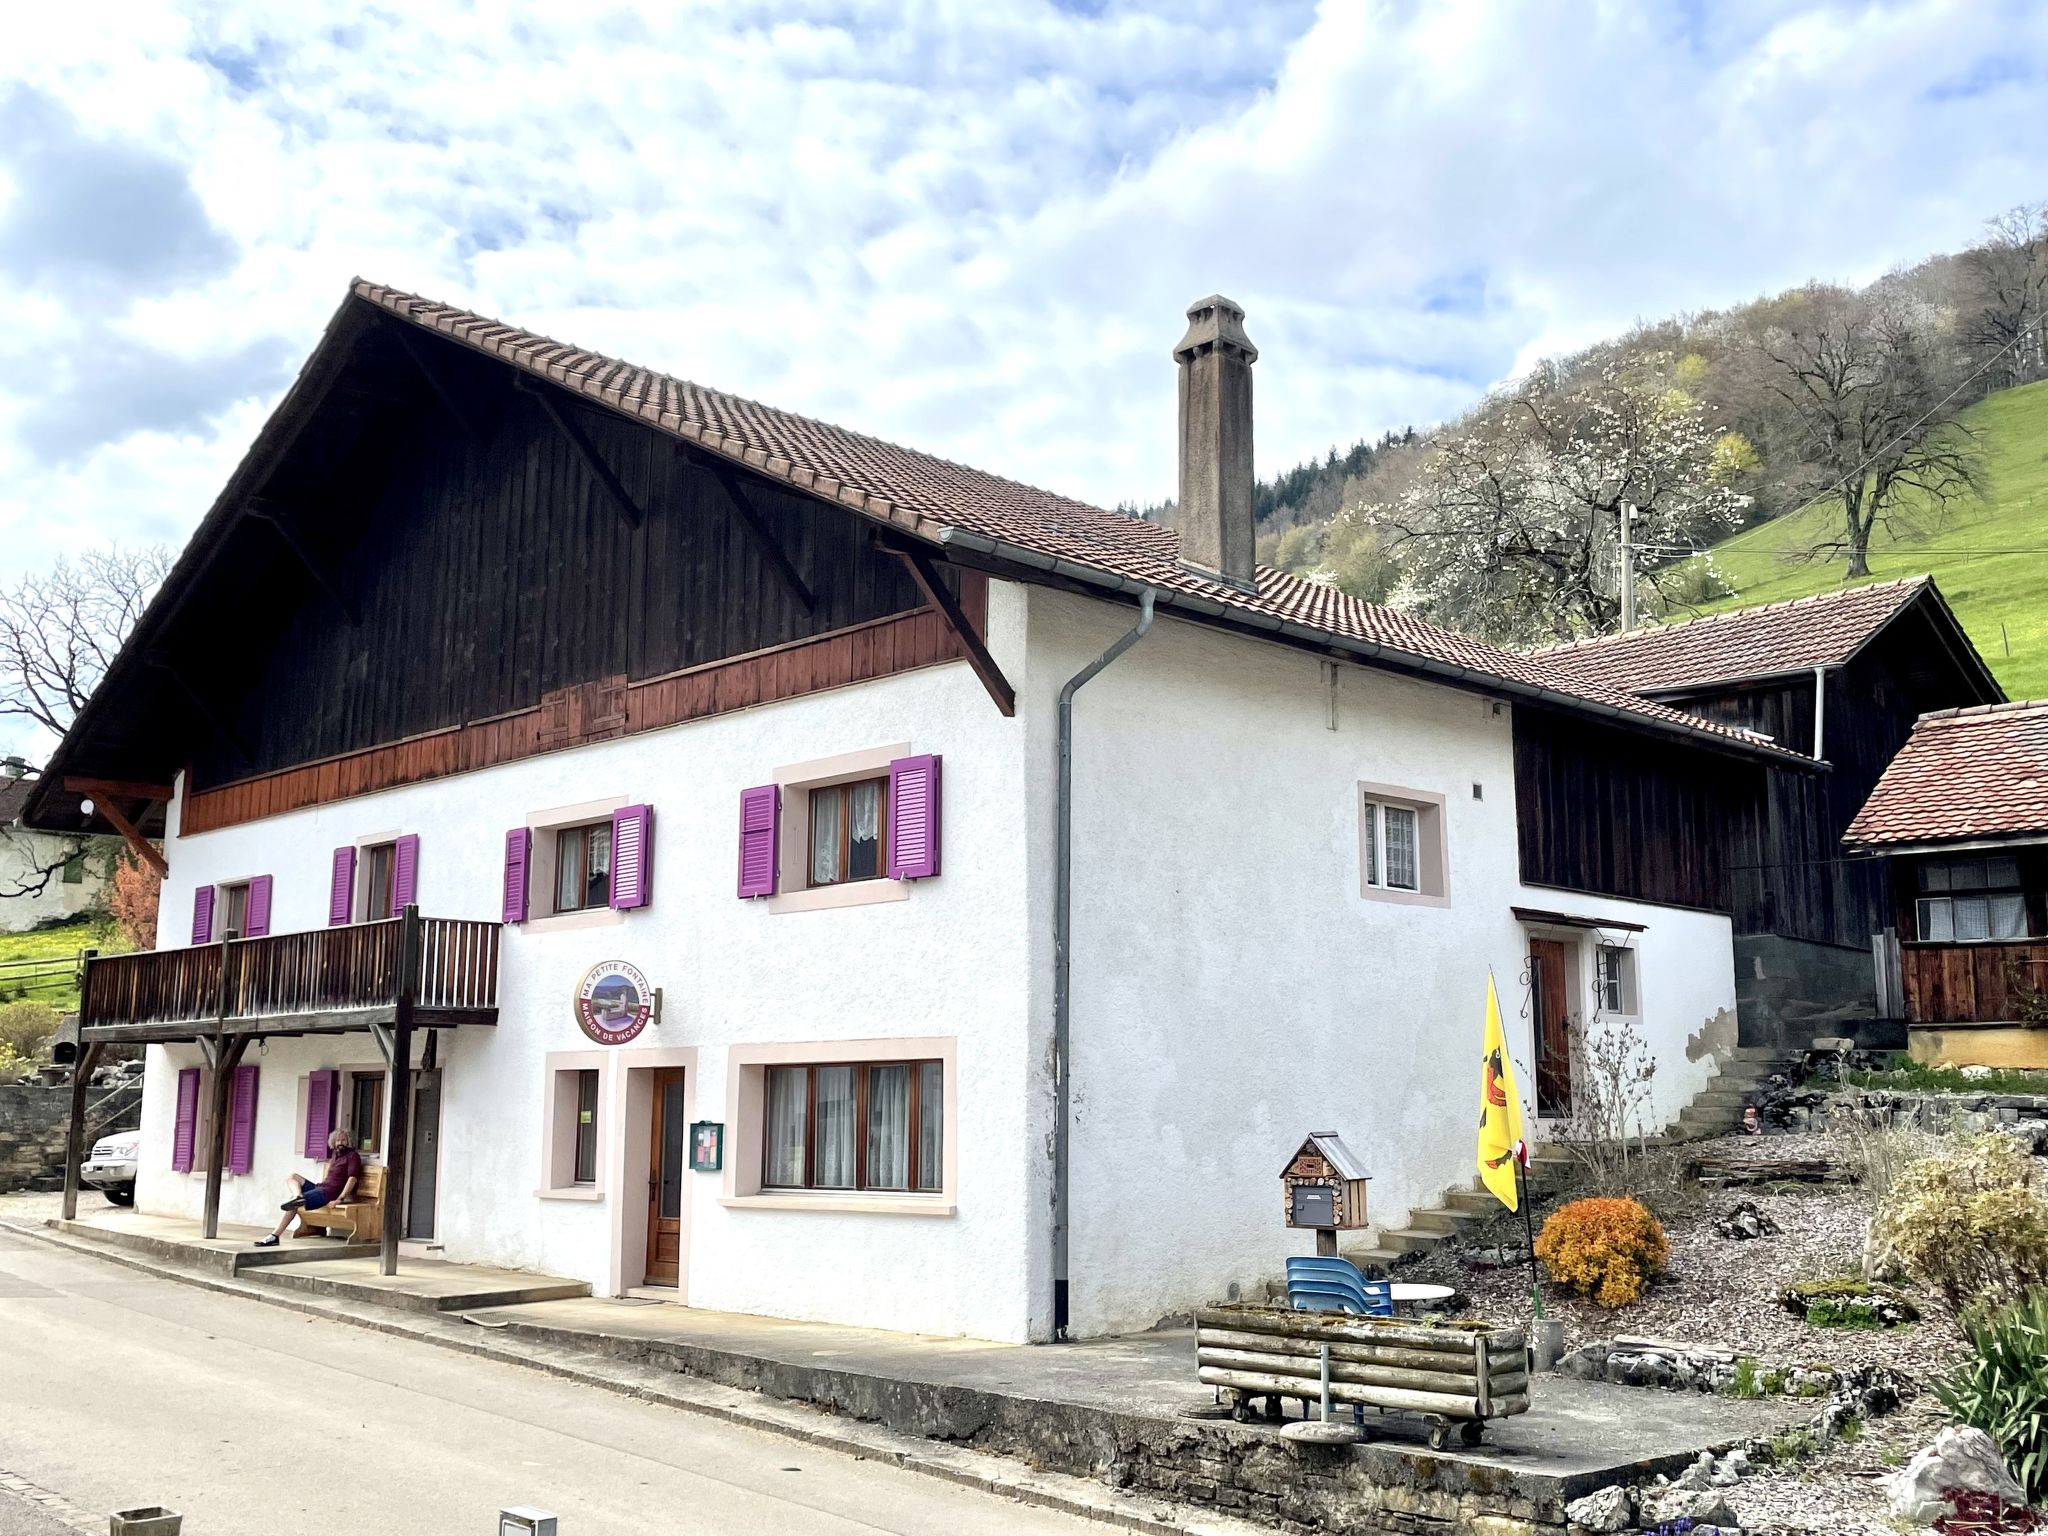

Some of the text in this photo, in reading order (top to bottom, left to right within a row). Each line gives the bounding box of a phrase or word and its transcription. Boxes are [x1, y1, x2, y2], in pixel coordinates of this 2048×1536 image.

[583, 963, 649, 1004] MA PETITE FONTAINE
[582, 1003, 648, 1041] MAISON DE VACANCES
